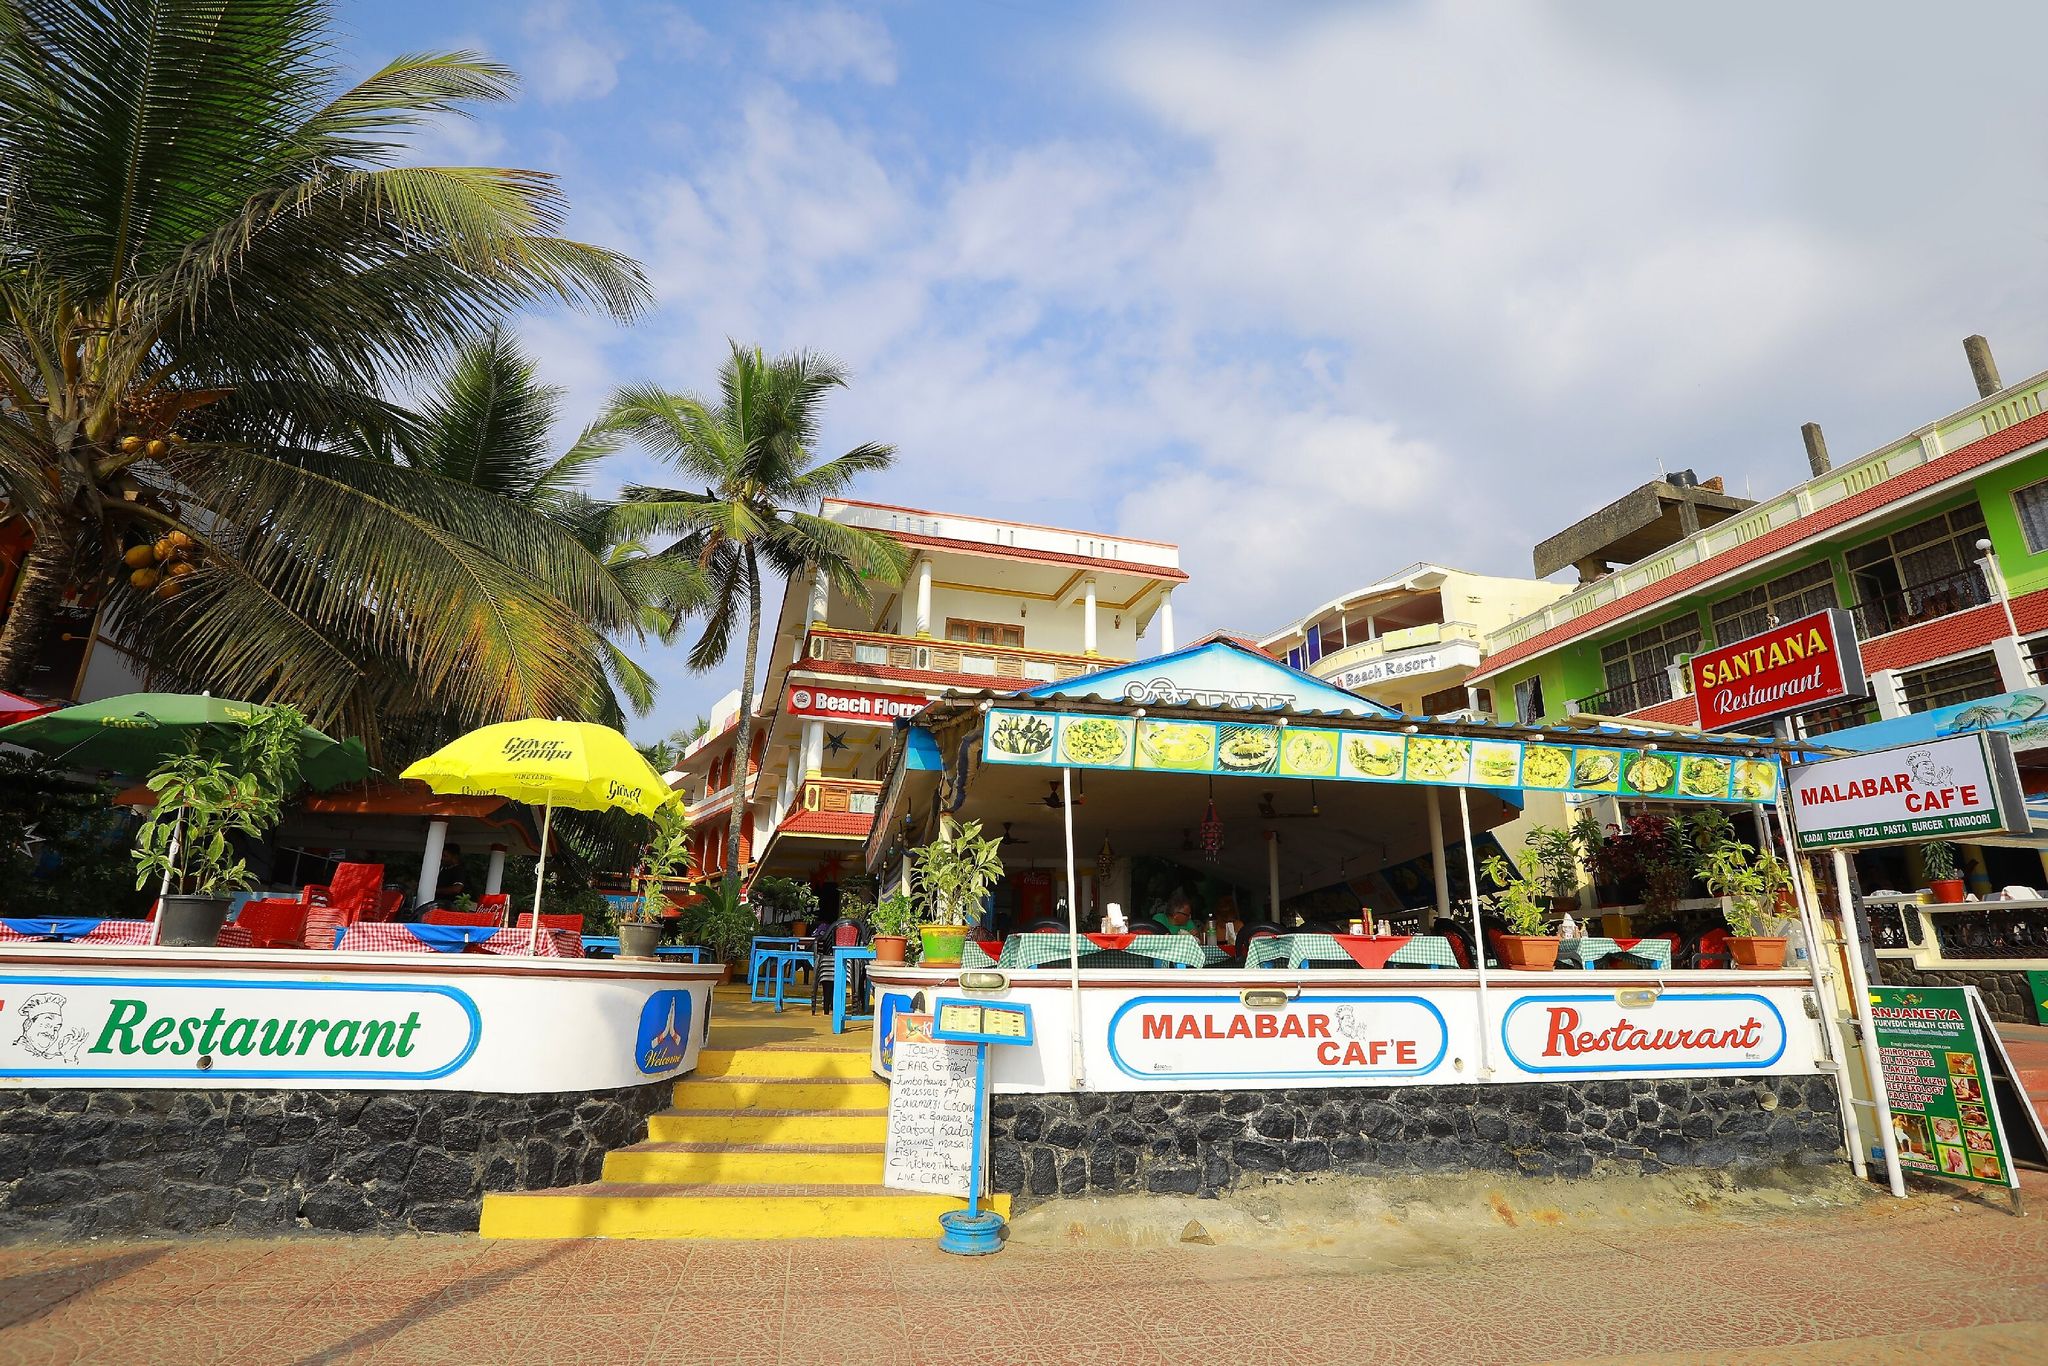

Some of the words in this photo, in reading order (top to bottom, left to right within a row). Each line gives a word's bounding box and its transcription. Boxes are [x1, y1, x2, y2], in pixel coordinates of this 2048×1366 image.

[1702, 628, 1828, 689] SANTANA
[1345, 664, 1382, 687] Beach
[1385, 655, 1436, 675] Resort
[1713, 664, 1823, 715] Restaurant
[815, 692, 866, 714] Beach
[501, 736, 564, 754] Grover
[507, 749, 573, 762] Zampa
[1800, 773, 1913, 806] MALABAR
[1803, 833, 1824, 843] KADAI
[1827, 830, 1855, 841] SIZZLER
[1858, 828, 1879, 838] PIZZA
[1883, 824, 1908, 835] PASTA
[1911, 820, 1944, 831] BURGER
[1947, 813, 1991, 828] TANDOORI
[1871, 1007, 1963, 1021] ANJANEYA
[87, 999, 421, 1058] Restaurant
[1142, 1014, 1332, 1039] MALABAR
[1541, 1007, 1762, 1057] Restaurant
[1873, 1019, 1908, 1028] YURVEDIC
[1909, 1021, 1935, 1029] HEALTH
[1937, 1022, 1965, 1030] CENTRE
[644, 1047, 682, 1069] Welcome
[1880, 1047, 1932, 1058] SHIRODHARA
[897, 1060, 929, 1071] CRAB
[1881, 1056, 1895, 1065] OIL
[1895, 1057, 1935, 1067] MASSAGE
[1922, 1076, 1947, 1086] KIZHI
[1886, 1083, 1945, 1095] REFLEXOLOGY
[1888, 1091, 1909, 1100] FACE
[1910, 1094, 1934, 1103] PACK
[1890, 1100, 1925, 1111] NASYAM
[891, 1121, 935, 1136] Seafood
[896, 1136, 934, 1147] Prawns
